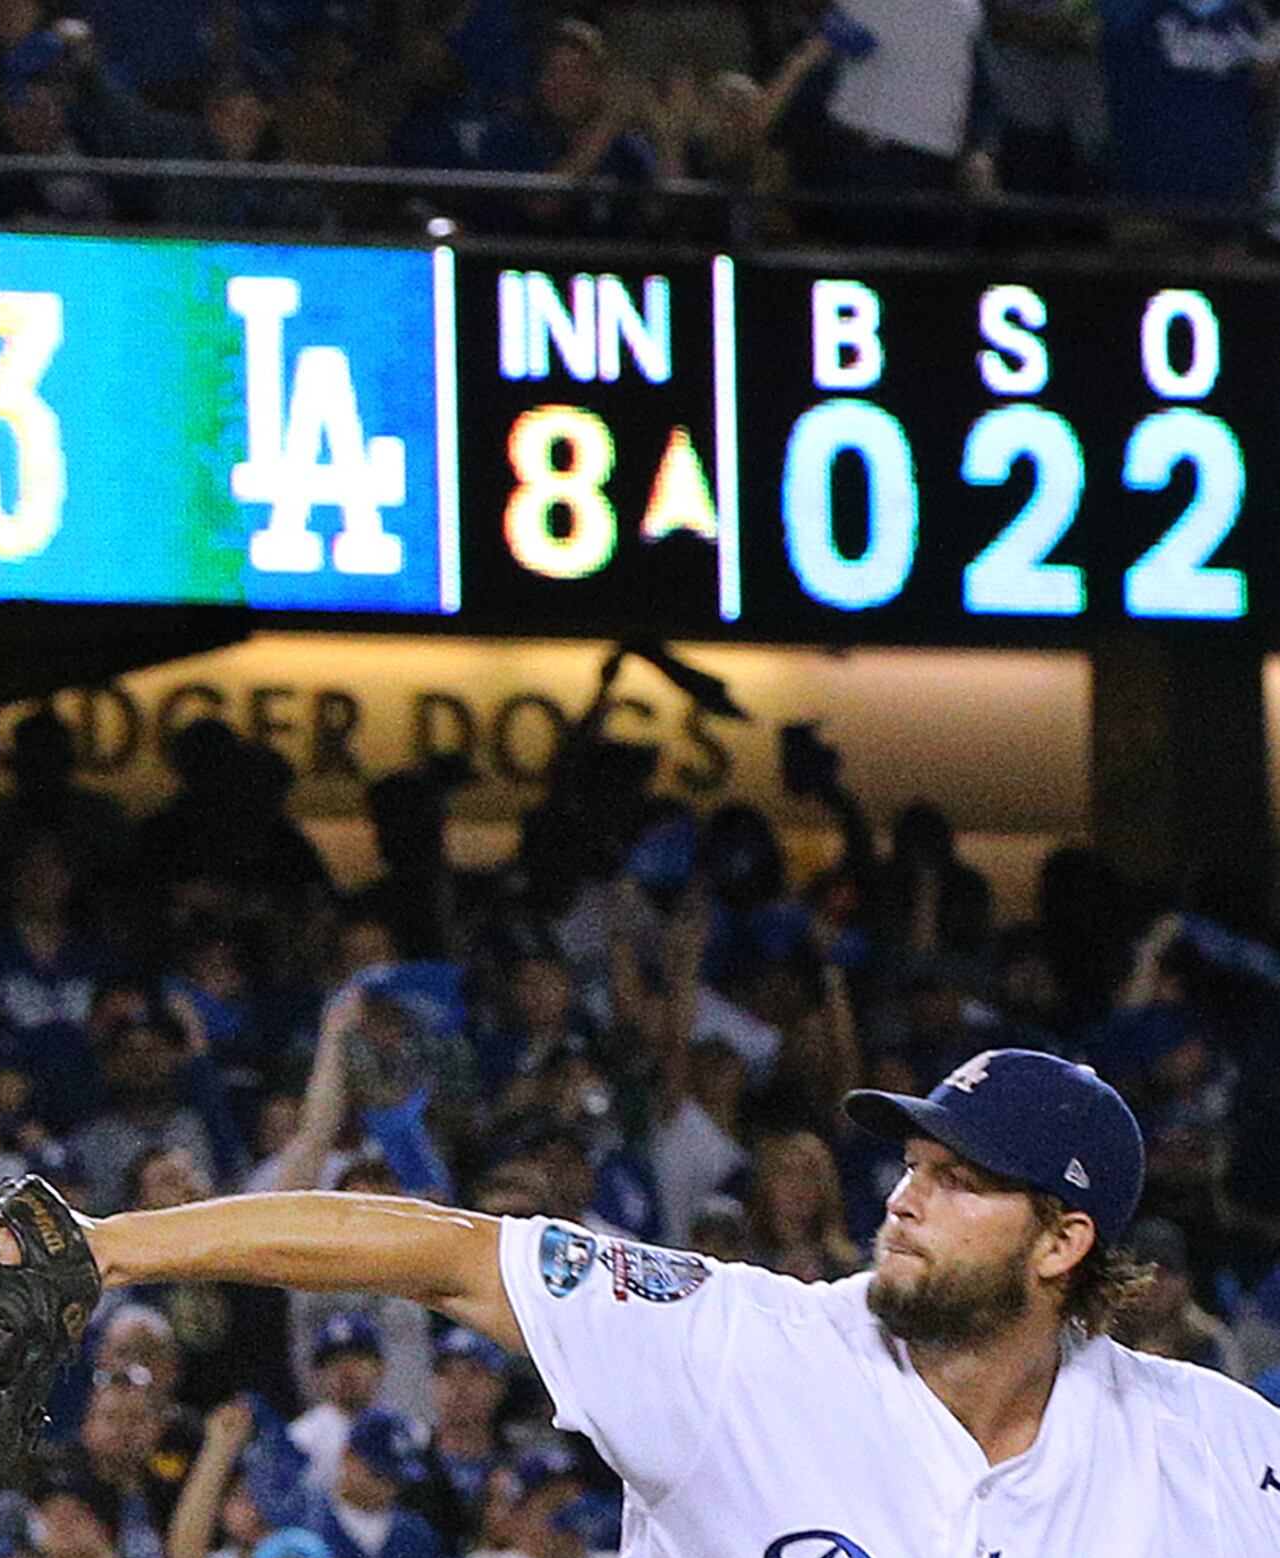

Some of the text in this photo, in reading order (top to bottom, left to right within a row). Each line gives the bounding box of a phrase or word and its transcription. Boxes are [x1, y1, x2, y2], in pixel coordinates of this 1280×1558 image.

[498, 270, 670, 383] INN
[811, 280, 885, 391] B
[978, 285, 1048, 396] S
[227, 277, 405, 574] LA
[504, 405, 616, 580] 8
[781, 399, 1248, 620] 0 2 2
